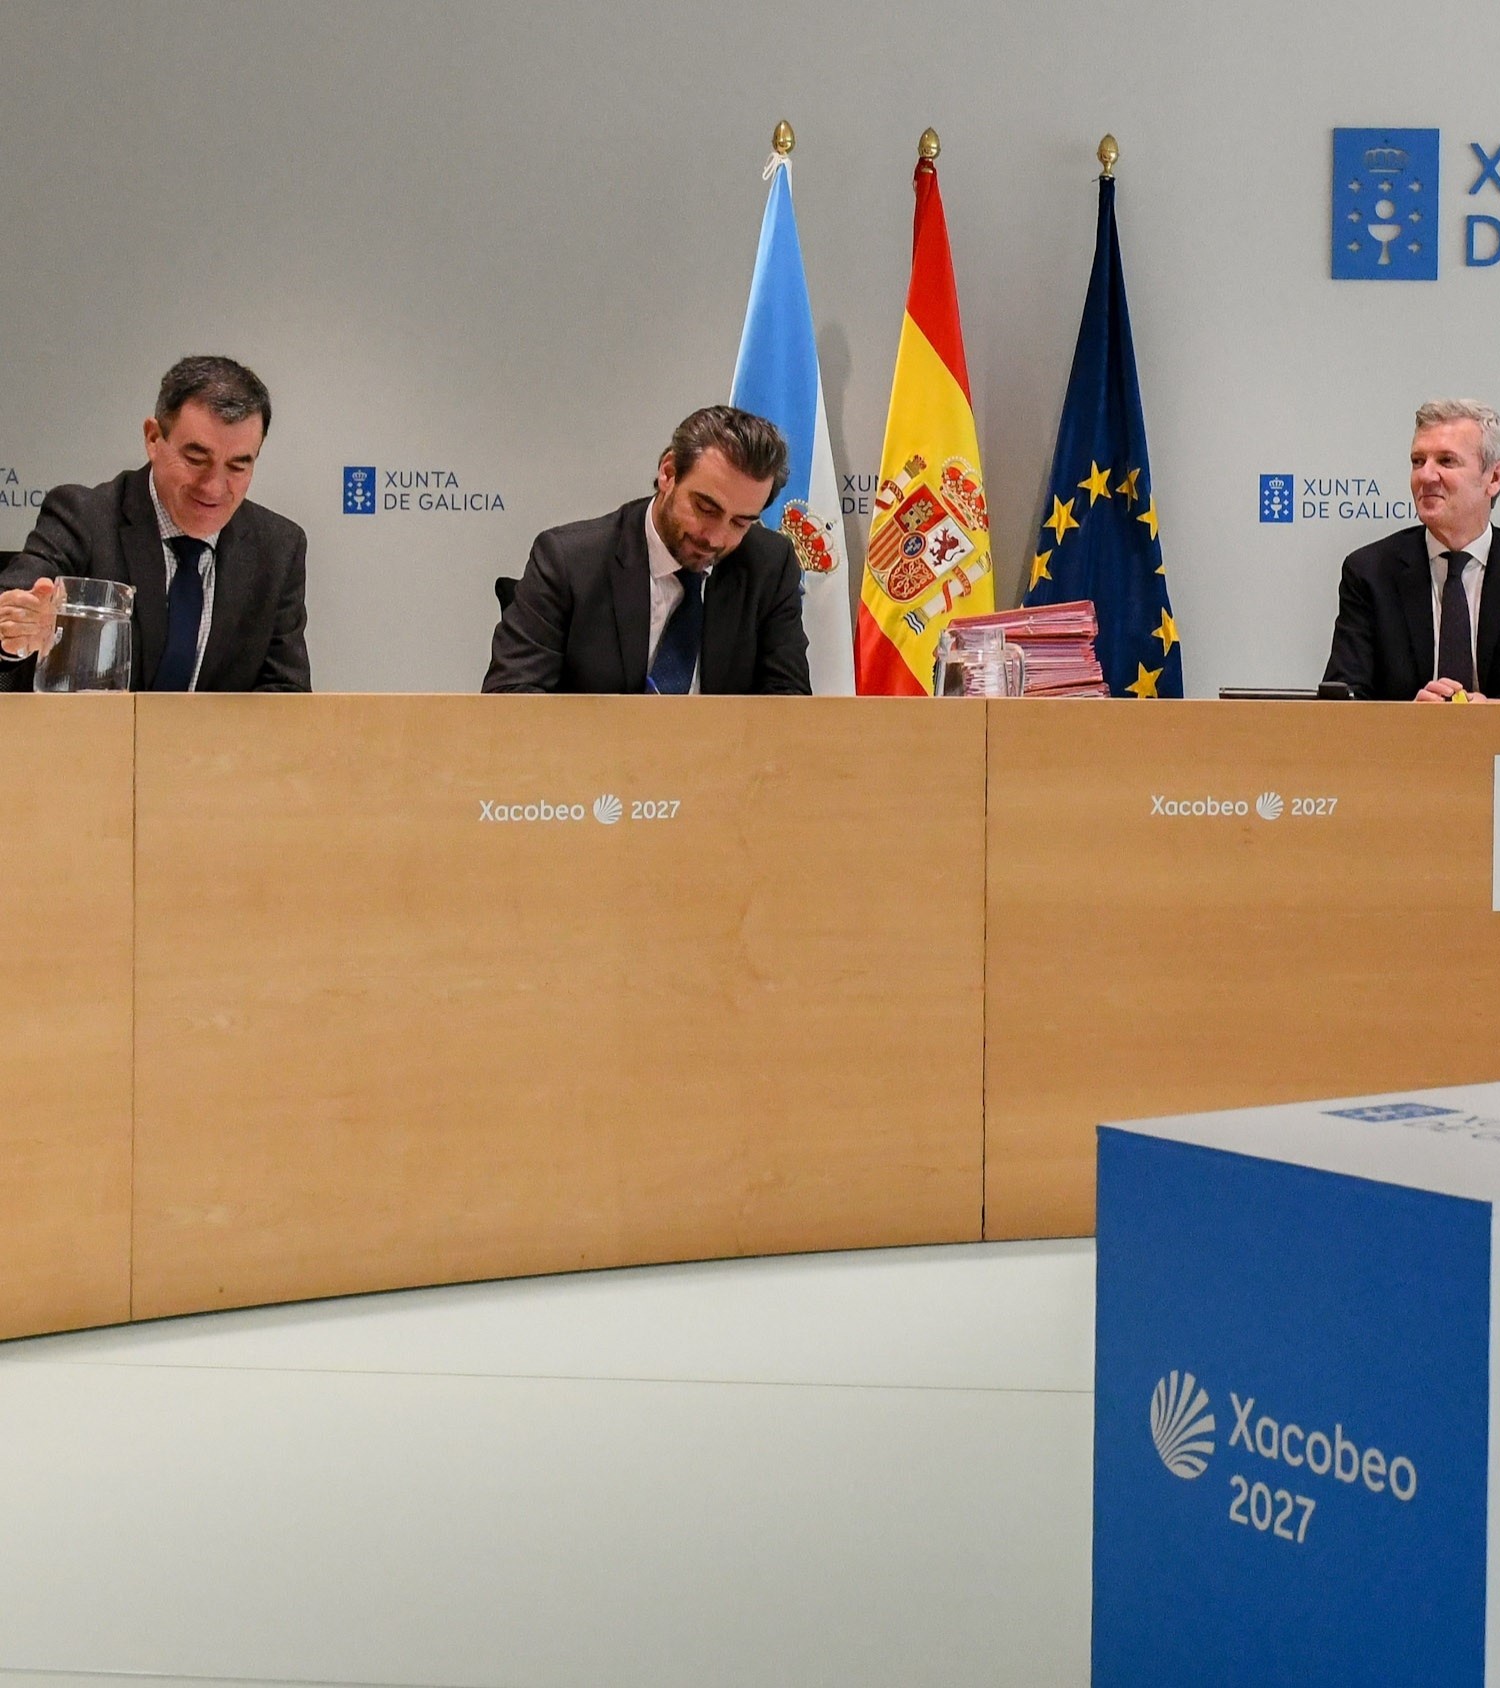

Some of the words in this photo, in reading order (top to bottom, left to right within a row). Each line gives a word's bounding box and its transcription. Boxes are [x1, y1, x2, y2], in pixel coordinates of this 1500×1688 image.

[385, 471, 459, 488] XUNTA
[1303, 478, 1380, 496] XUNTA
[384, 493, 410, 511] DE
[418, 493, 505, 511] GALICIA
[842, 497, 869, 514] DE
[1302, 501, 1329, 519] DE
[1338, 501, 1419, 519] GALICI
[479, 799, 585, 821] Xacobeo
[631, 800, 680, 819] 2027
[1150, 795, 1248, 816] Xacobeo
[1291, 798, 1338, 815] 2027
[1229, 1392, 1417, 1501] Xacobeo
[1229, 1474, 1317, 1543] 2027
